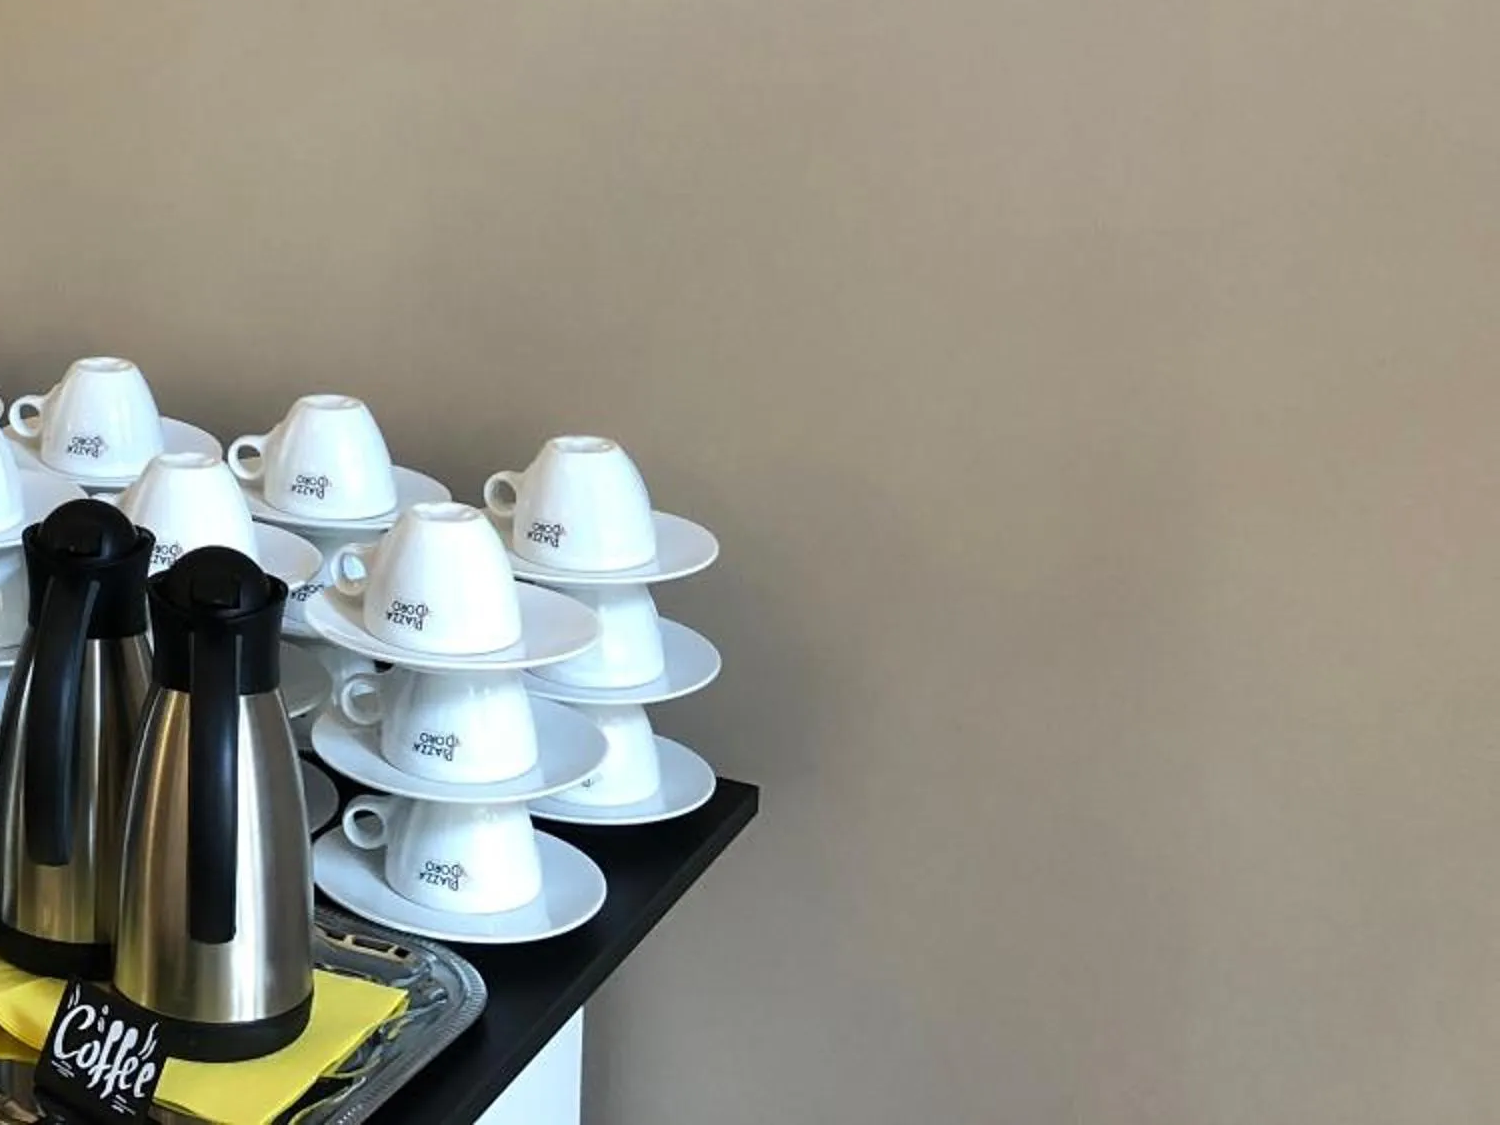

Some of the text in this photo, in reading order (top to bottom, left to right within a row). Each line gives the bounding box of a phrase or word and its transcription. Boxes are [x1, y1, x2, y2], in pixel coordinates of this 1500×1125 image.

[291, 484, 325, 499] PIAZZA
[387, 611, 423, 631] PIAZZA
[412, 742, 454, 761] PIAZZA
[419, 872, 459, 891] PIAZZA
[53, 1004, 156, 1099] Coffee
